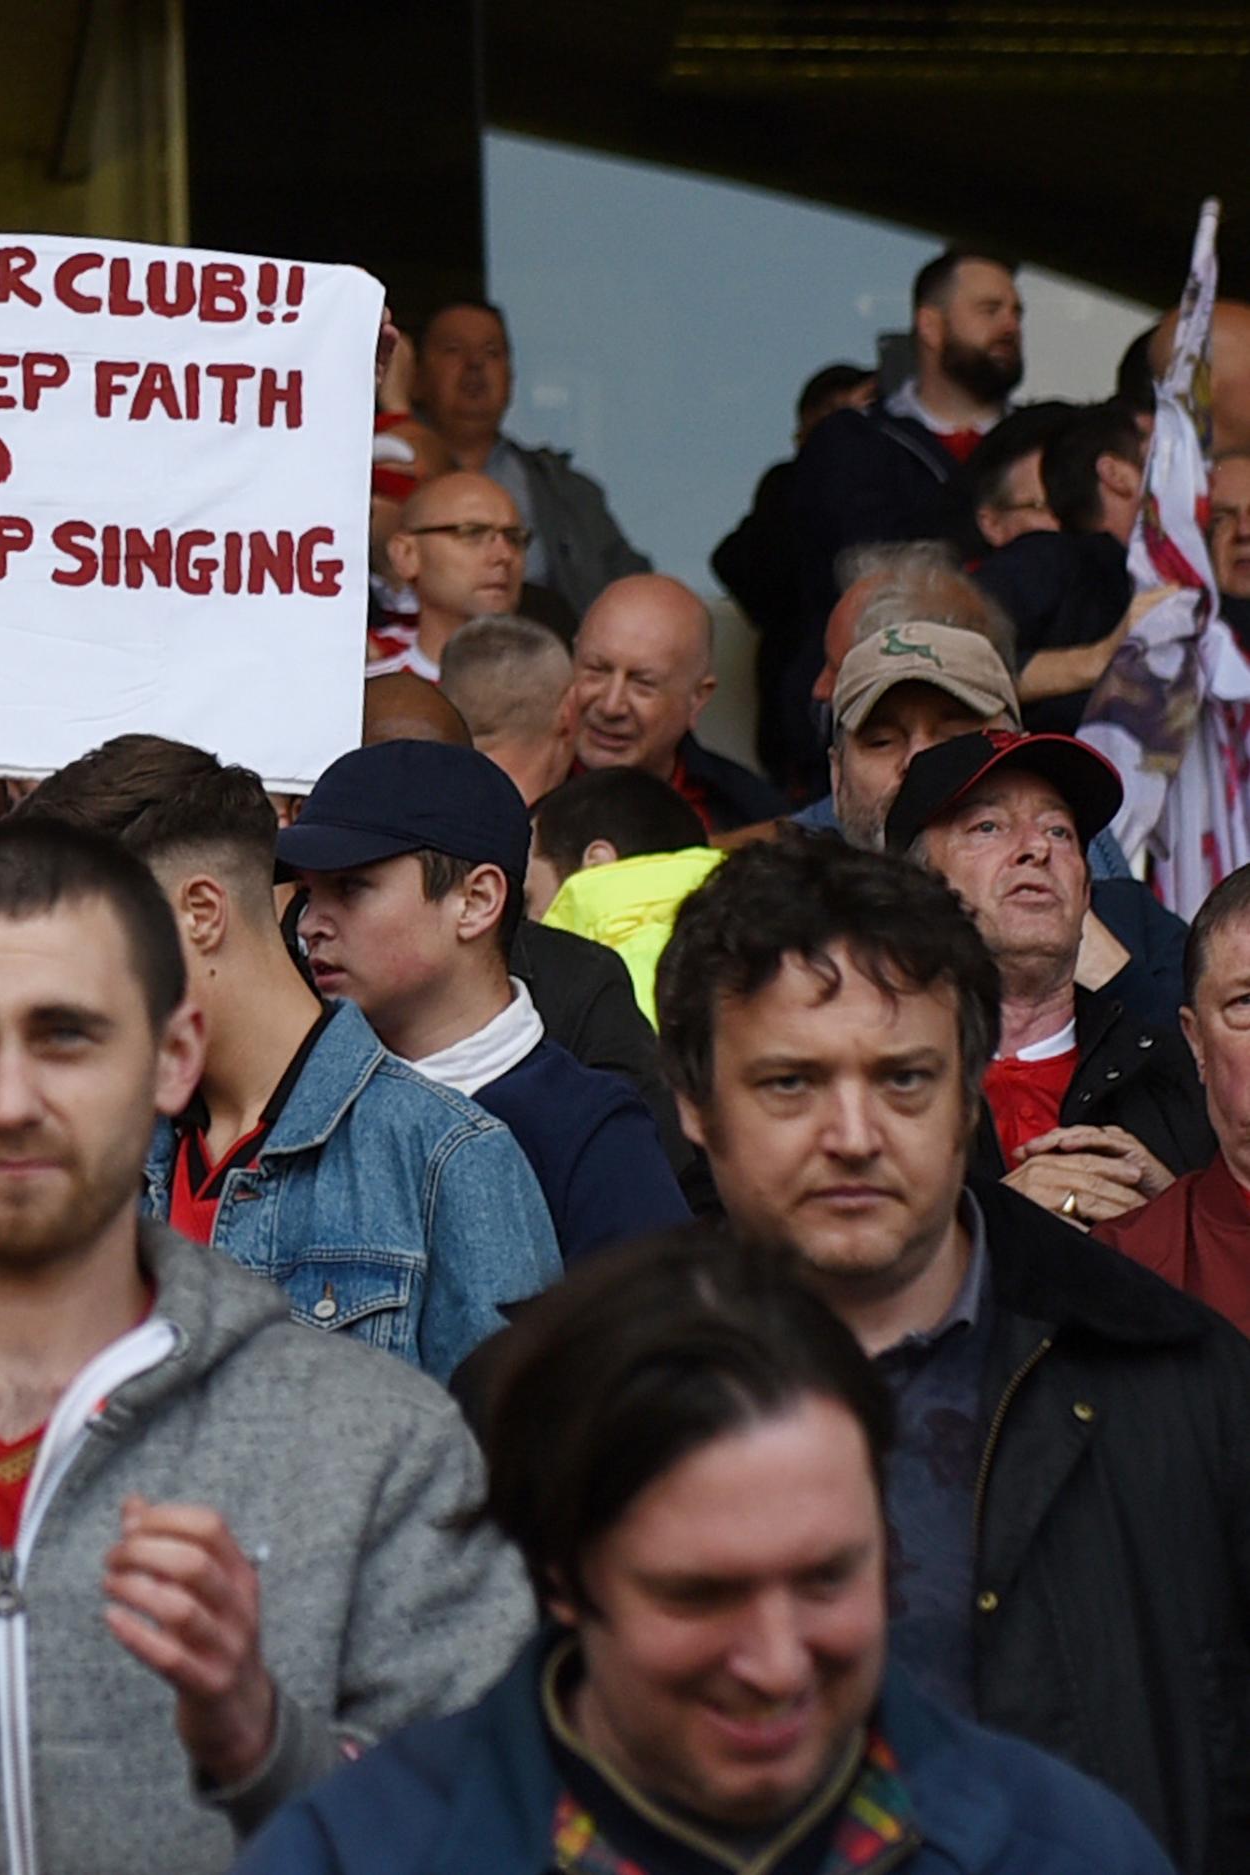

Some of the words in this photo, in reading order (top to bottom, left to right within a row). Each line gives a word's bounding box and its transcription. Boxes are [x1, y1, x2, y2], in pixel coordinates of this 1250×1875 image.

[53, 252, 305, 325] CLUB!!
[94, 360, 303, 429] FAITH
[51, 520, 345, 597] SINGING
